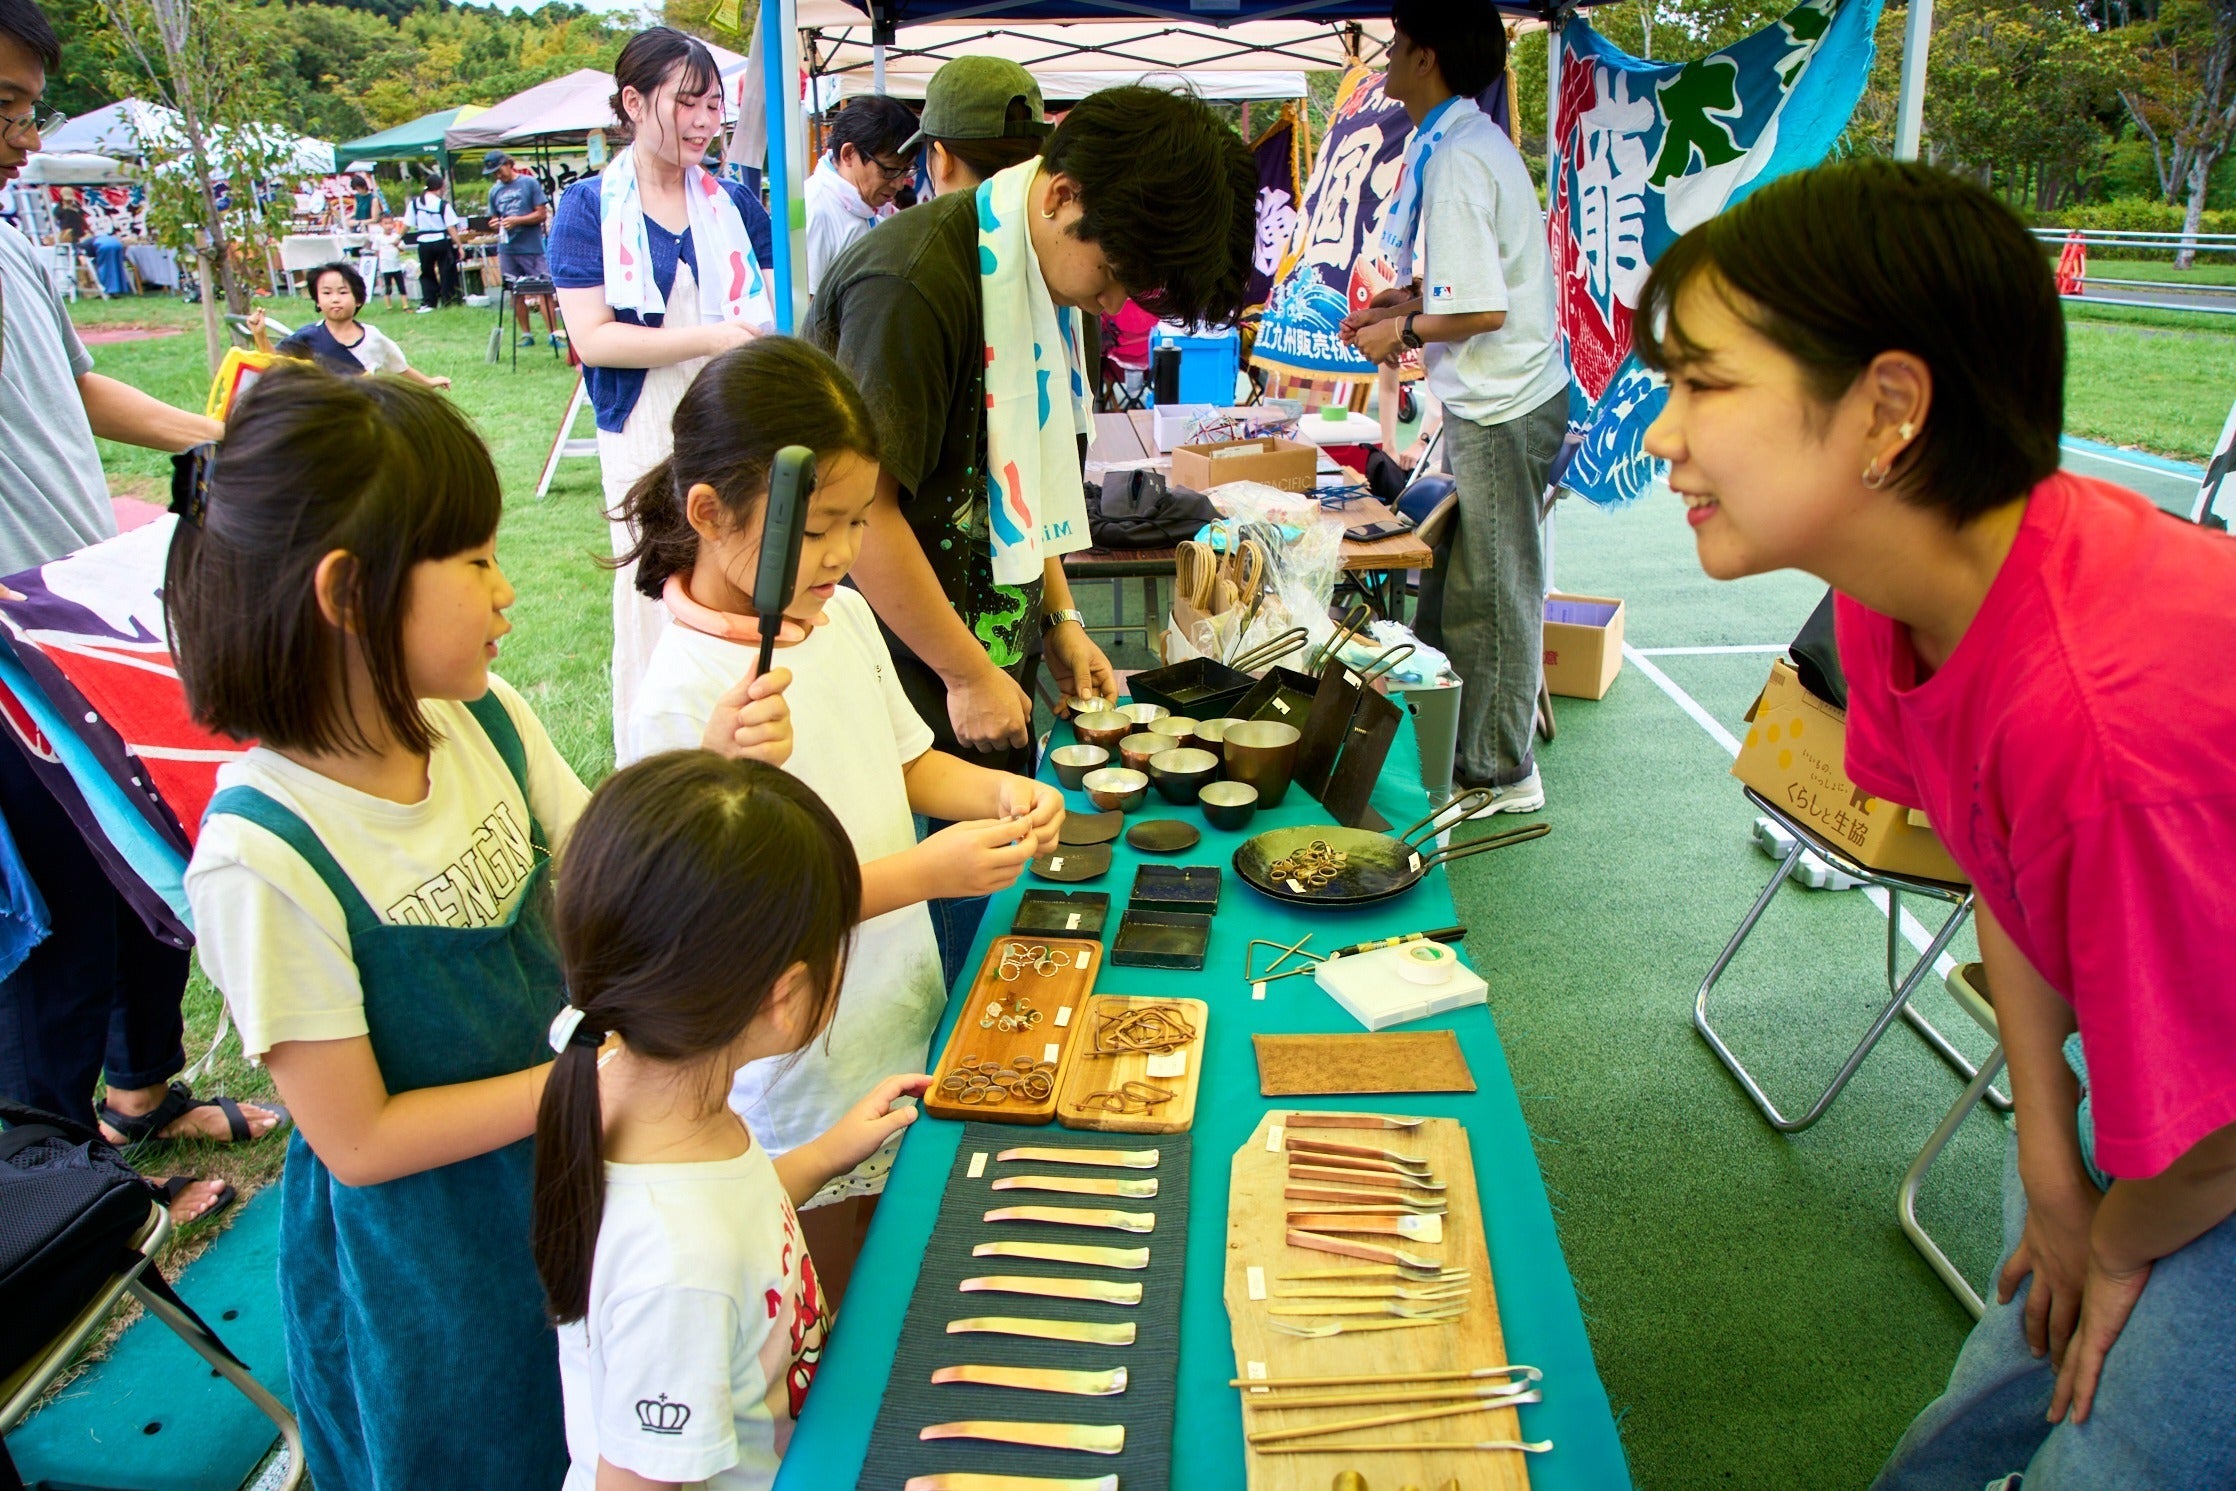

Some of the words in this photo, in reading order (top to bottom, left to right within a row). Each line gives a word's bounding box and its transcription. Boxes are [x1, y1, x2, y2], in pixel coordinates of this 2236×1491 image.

[1261, 476, 1312, 491] PACIFIC
[1787, 782, 1869, 847] くらしと生協
